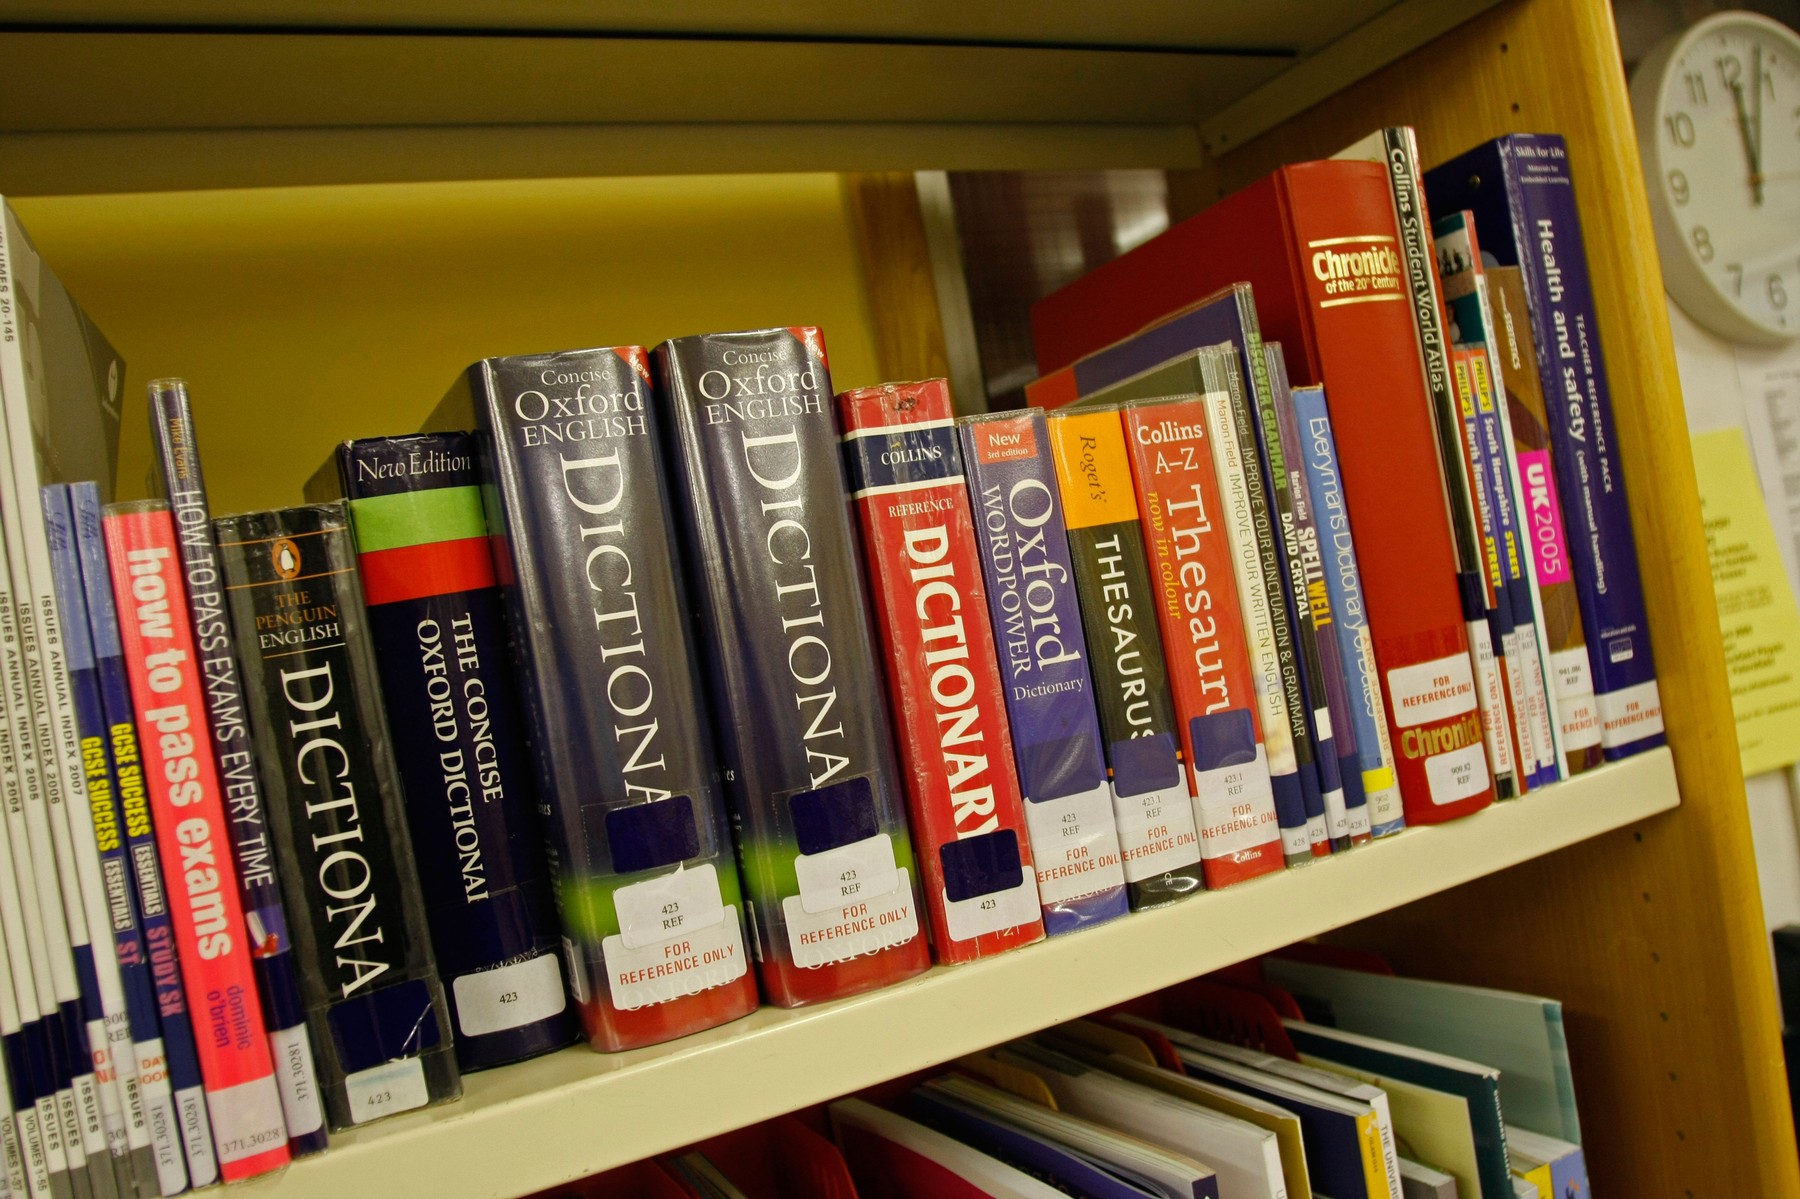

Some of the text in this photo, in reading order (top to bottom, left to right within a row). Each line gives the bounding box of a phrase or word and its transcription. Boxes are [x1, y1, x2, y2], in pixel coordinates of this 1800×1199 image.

[1762, 68, 1776, 102] 1
[1664, 110, 1696, 149] 10
[1515, 145, 1565, 159] Skills Life
[1667, 168, 1690, 208] 9
[1312, 245, 1401, 281] Chronicle
[1691, 224, 1715, 264] 8
[1325, 275, 1400, 294] of the Century
[1390, 147, 1412, 213] Collins
[1403, 216, 1426, 290] Student
[1417, 291, 1437, 345] World
[1427, 348, 1444, 393] Atlas
[1725, 262, 1744, 298] 7
[1765, 272, 1789, 311] 6
[722, 347, 788, 366] Concise
[1536, 218, 1589, 484] Health and safety (with
[541, 365, 611, 387] Concise
[698, 360, 819, 401] Oxford
[1474, 360, 1491, 408] PHILIP'S
[514, 381, 644, 422] Oxford
[704, 393, 823, 426] ENGLISH
[1247, 332, 1288, 490] DISCOVER GRAMMAR
[1575, 313, 1614, 495] TEACHER REFERENCE PACK
[169, 416, 189, 480] Mike Evans
[520, 414, 648, 448] ENGLISH
[988, 431, 1021, 448] New
[1136, 420, 1203, 446] Collins
[1456, 364, 1492, 533] PHILIP'S North Hampshire
[1484, 417, 1500, 455] South
[357, 450, 472, 482] New Edition
[881, 445, 943, 466] COLLINS
[1001, 447, 1029, 458] edition
[1079, 434, 1106, 500] Roget's
[888, 496, 954, 518] REFERENCE
[1491, 457, 1510, 527] Hampshire
[1526, 462, 1562, 576] UK2005
[1009, 478, 1082, 671] Oxford
[1147, 491, 1181, 619] now in colour
[1217, 399, 1282, 717] Marion Field IMPROVE YOUR WRITTEN ENGLISH
[1236, 409, 1306, 738] Field IMPROVE YOUR PUNCTUATION & GRAMMAR
[1281, 512, 1310, 620] DAVID CRYSTAL
[982, 483, 1032, 679] WORDPOWER
[1297, 526, 1333, 632] SPELL WELL
[1333, 531, 1365, 631] Dictionary
[255, 604, 338, 630] PENGUIN
[274, 590, 311, 609] THE
[741, 424, 850, 790] DICTIONA
[259, 622, 341, 649] ENGLISH
[41, 594, 83, 796] ISSUES ANNUAL INDEX 2007
[174, 490, 274, 888] HOW TO PASS EXAMS EVERY TIME
[417, 618, 458, 742] OXFORD
[1013, 677, 1085, 701] Dictionary
[1402, 681, 1473, 709] REFERENCE ONLY
[1433, 674, 1451, 689] FOR
[1487, 671, 1498, 701] ONLY
[20, 602, 60, 805] ISSUES ANNUAL INDEX 2006
[451, 612, 504, 803] THE CONCISE
[1626, 701, 1641, 714] FOR
[7, 649, 39, 800] ANNUAL INDEX 2005
[1492, 703, 1508, 766] REFERENCE
[127, 547, 233, 961] how to pass exams
[6, 781, 20, 813] 2004
[80, 736, 122, 852] GCSE SUCCESS
[111, 723, 151, 838] GCSE SUCCESS
[1227, 785, 1244, 796] REF
[1456, 773, 1471, 786] REF
[280, 660, 390, 999] DICTIONA
[1061, 812, 1077, 824] 423
[1145, 808, 1162, 819] REF
[1200, 815, 1258, 840] REFERENCE
[1231, 803, 1252, 817] FOR
[1350, 817, 1368, 830] 428.1
[1061, 825, 1080, 837] REF
[1147, 825, 1168, 840] FOR
[1065, 846, 1089, 861] FOR
[134, 845, 163, 917] ESSENTIALS
[840, 869, 857, 882] 423
[840, 883, 862, 897] REF
[103, 860, 132, 931] ESSENTIALS
[661, 902, 680, 915] 423
[842, 903, 869, 920] FOR
[980, 898, 998, 911] 423
[661, 915, 685, 930] REF
[799, 905, 908, 945] REFERENCE ONLY
[146, 924, 179, 986] STUDY
[619, 952, 700, 986] REFERENCE
[703, 944, 735, 964] ONLY
[664, 940, 691, 959] FOR
[225, 984, 251, 1050] dominic
[499, 991, 519, 1004] 423
[206, 990, 231, 1049] o'brien
[80, 1081, 99, 1133] ISSUES
[126, 1078, 145, 1129] ISSUES
[367, 1091, 392, 1107] 423
[41, 1098, 60, 1151] ISSUES
[61, 1095, 79, 1147] ISSUES
[24, 1115, 42, 1167] VOLUMES
